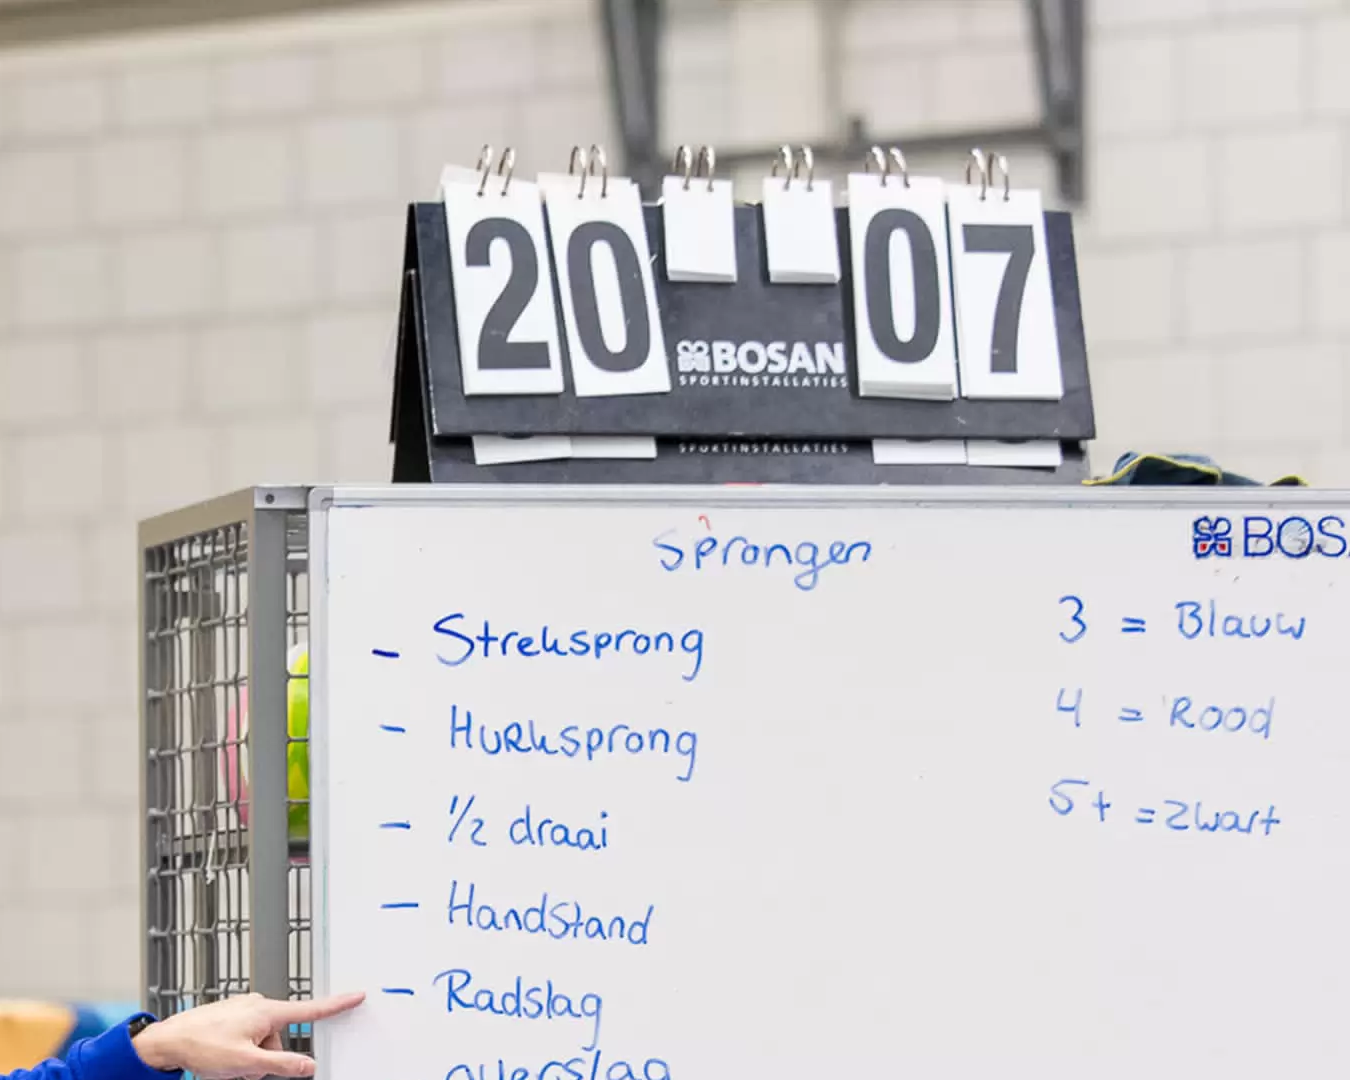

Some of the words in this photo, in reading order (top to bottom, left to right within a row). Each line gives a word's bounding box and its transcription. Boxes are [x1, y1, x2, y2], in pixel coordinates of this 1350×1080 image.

[679, 375, 849, 388] SPORTINSTALLATIES
[712, 341, 846, 374] BOSAN
[653, 528, 873, 592] Sprongen
[1242, 515, 1350, 559] BOS
[1058, 595, 1088, 644] 3
[1174, 599, 1306, 641] Blauw
[433, 612, 704, 682] Streksprong
[1056, 688, 1082, 729] 4
[1170, 696, 1275, 740] Rood
[508, 804, 610, 850] draai
[433, 968, 603, 1052] Radslag
